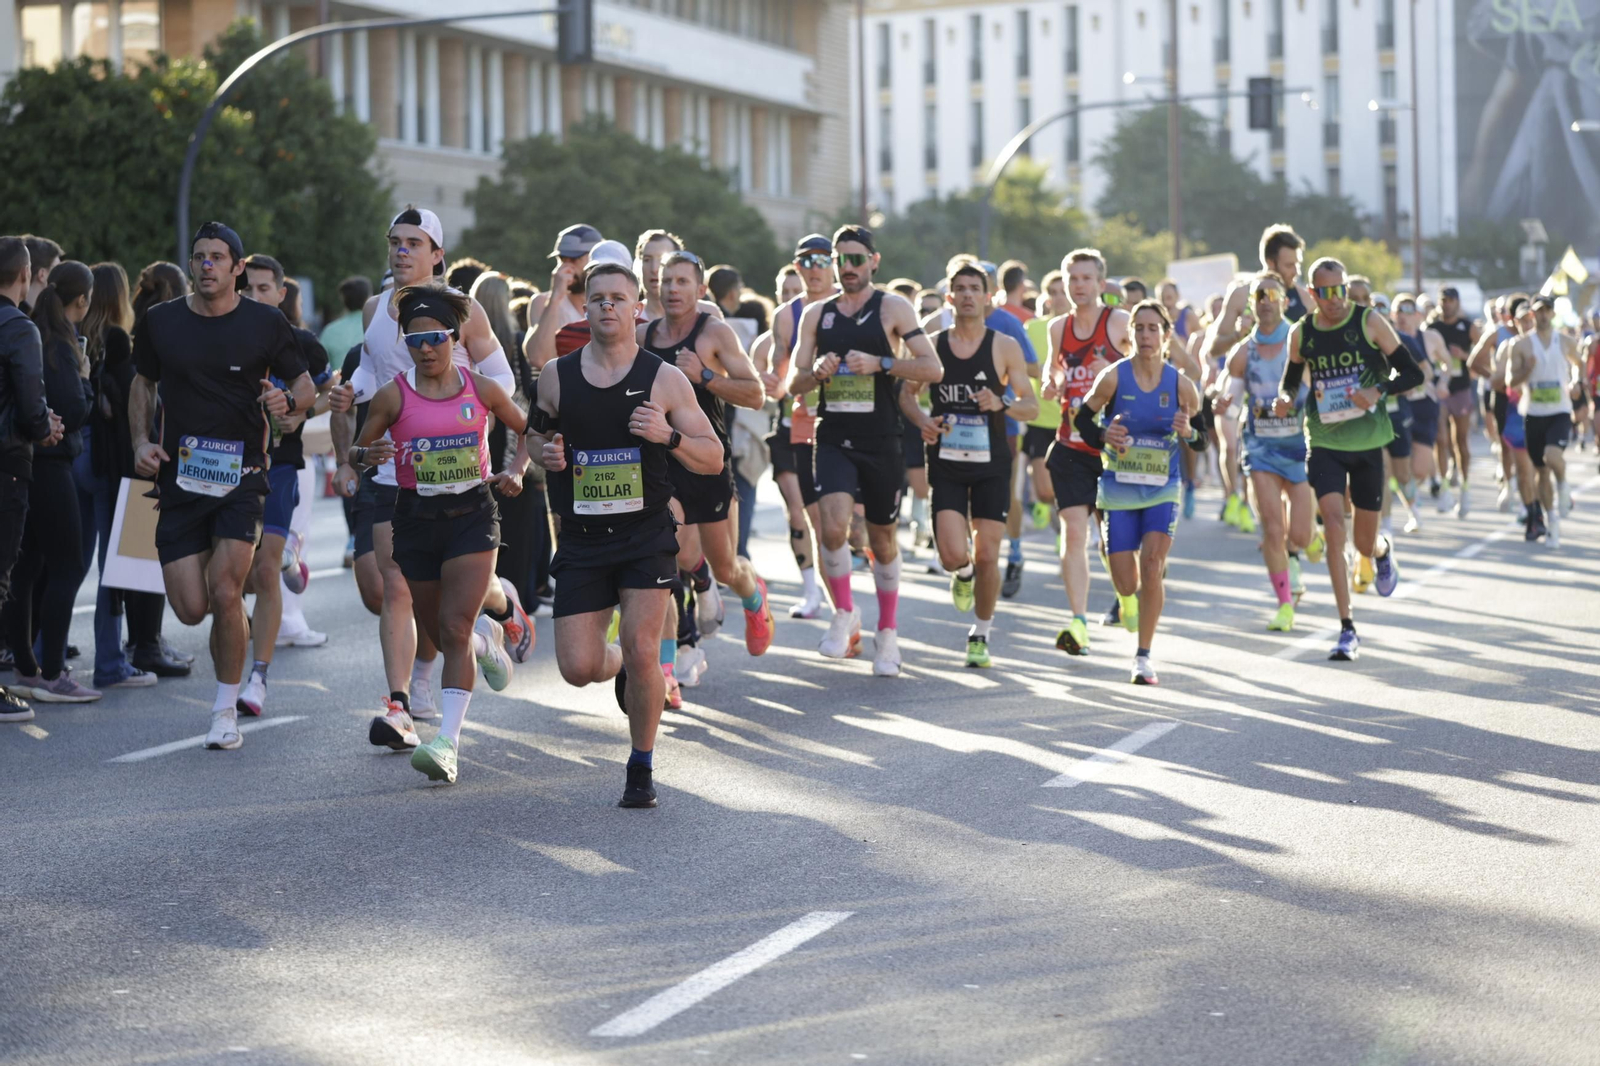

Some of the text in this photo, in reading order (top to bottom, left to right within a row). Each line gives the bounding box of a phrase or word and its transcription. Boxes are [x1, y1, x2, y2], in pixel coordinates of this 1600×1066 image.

[1491, 0, 1584, 33] SEA
[1313, 364, 1366, 378] TLETISMO
[938, 383, 986, 404] SIEN
[1328, 399, 1352, 412] JOAN
[201, 440, 237, 453] ZURICH
[435, 437, 472, 448] ZURICH
[1136, 438, 1165, 448] ZURICH
[201, 457, 220, 467] 7699
[437, 456, 458, 466] 2599
[592, 452, 632, 463] ZURICH
[180, 463, 239, 485] JERONIMO
[416, 465, 481, 483] LUZ NADINE
[1117, 460, 1168, 475] INMA DIAZ
[594, 471, 616, 482] 2162
[582, 483, 632, 498] COLLAR
